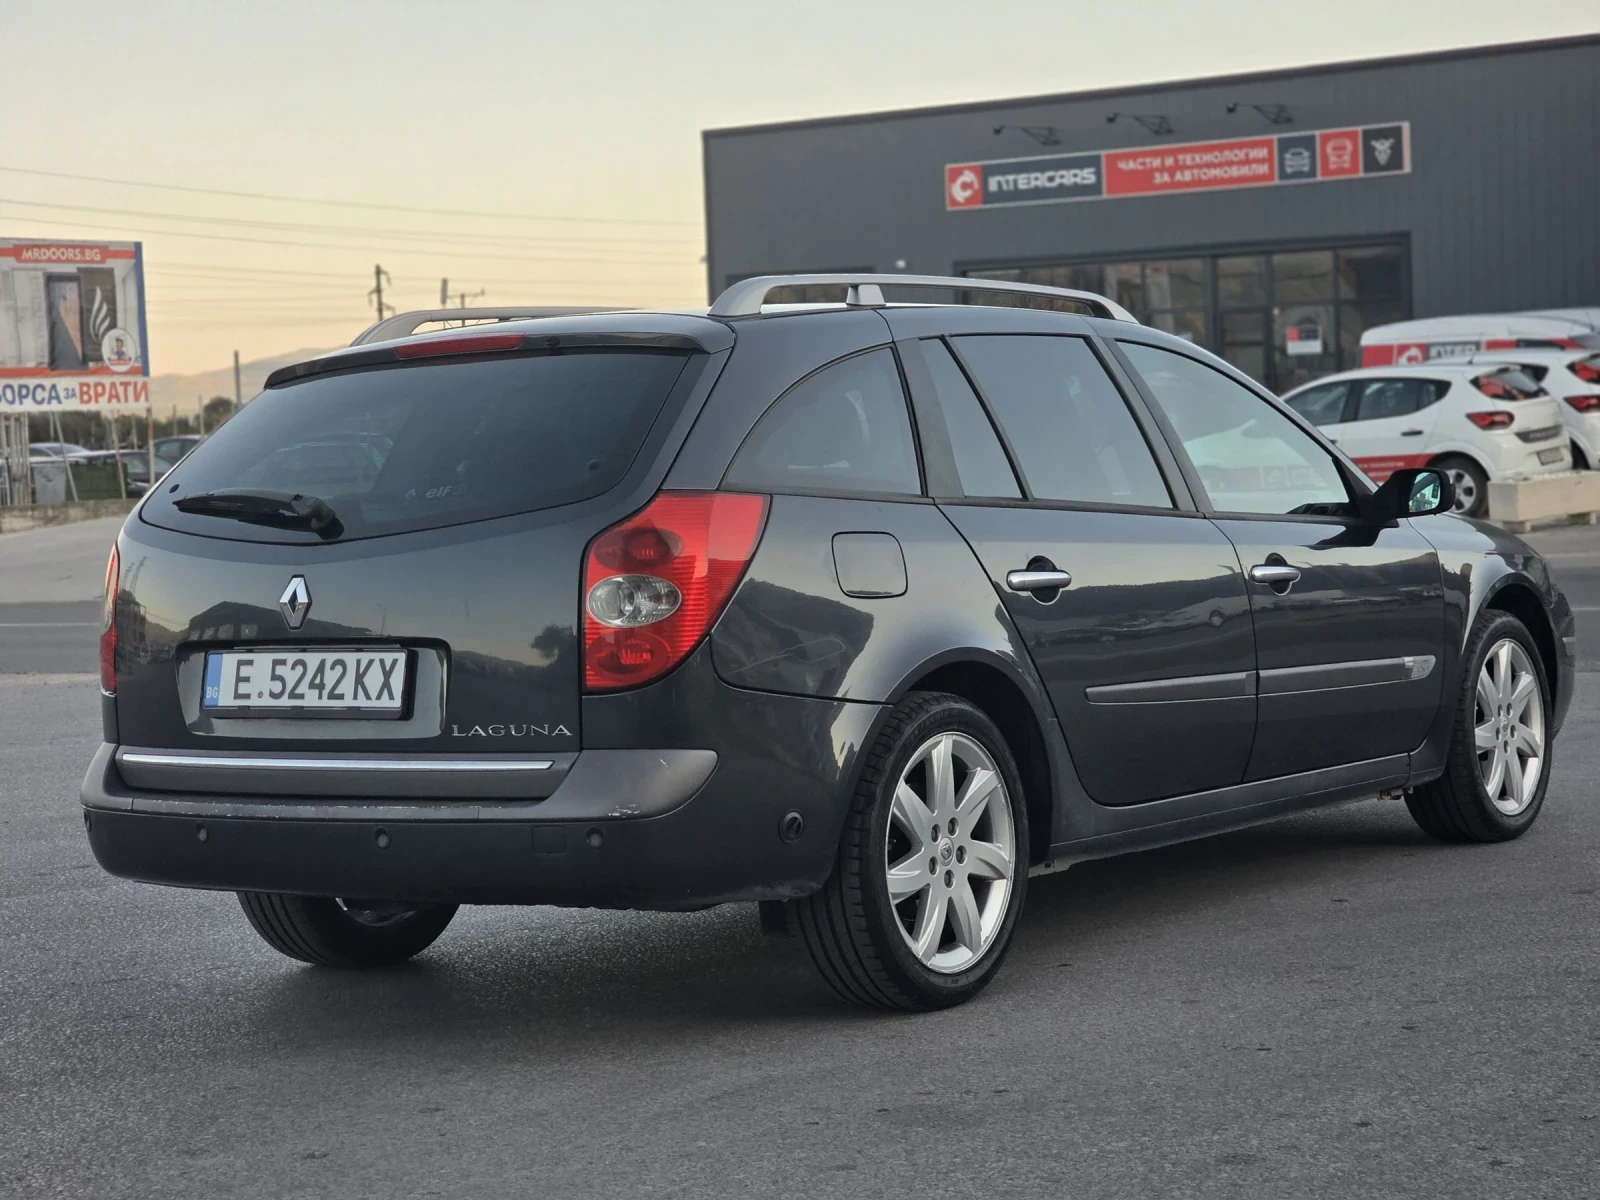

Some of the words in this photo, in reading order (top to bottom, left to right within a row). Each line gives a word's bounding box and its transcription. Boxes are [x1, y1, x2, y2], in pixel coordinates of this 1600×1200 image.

[1117, 156, 1161, 170] ЧАСТИ
[1165, 156, 1174, 167] И
[1178, 147, 1268, 165] ТЕХНОЛОГИИ
[988, 167, 1096, 192] INTERCARS
[1153, 172, 1170, 184] ЗА
[1174, 163, 1269, 182] АВТОМОБИЛИ
[21, 247, 101, 261] MRDOORS.BG
[0, 383, 62, 405] ОРСА
[63, 387, 77, 400] ЗА
[78, 381, 149, 405] ВРАТИ
[206, 686, 218, 699] BG
[451, 724, 573, 737] LAGUNA
